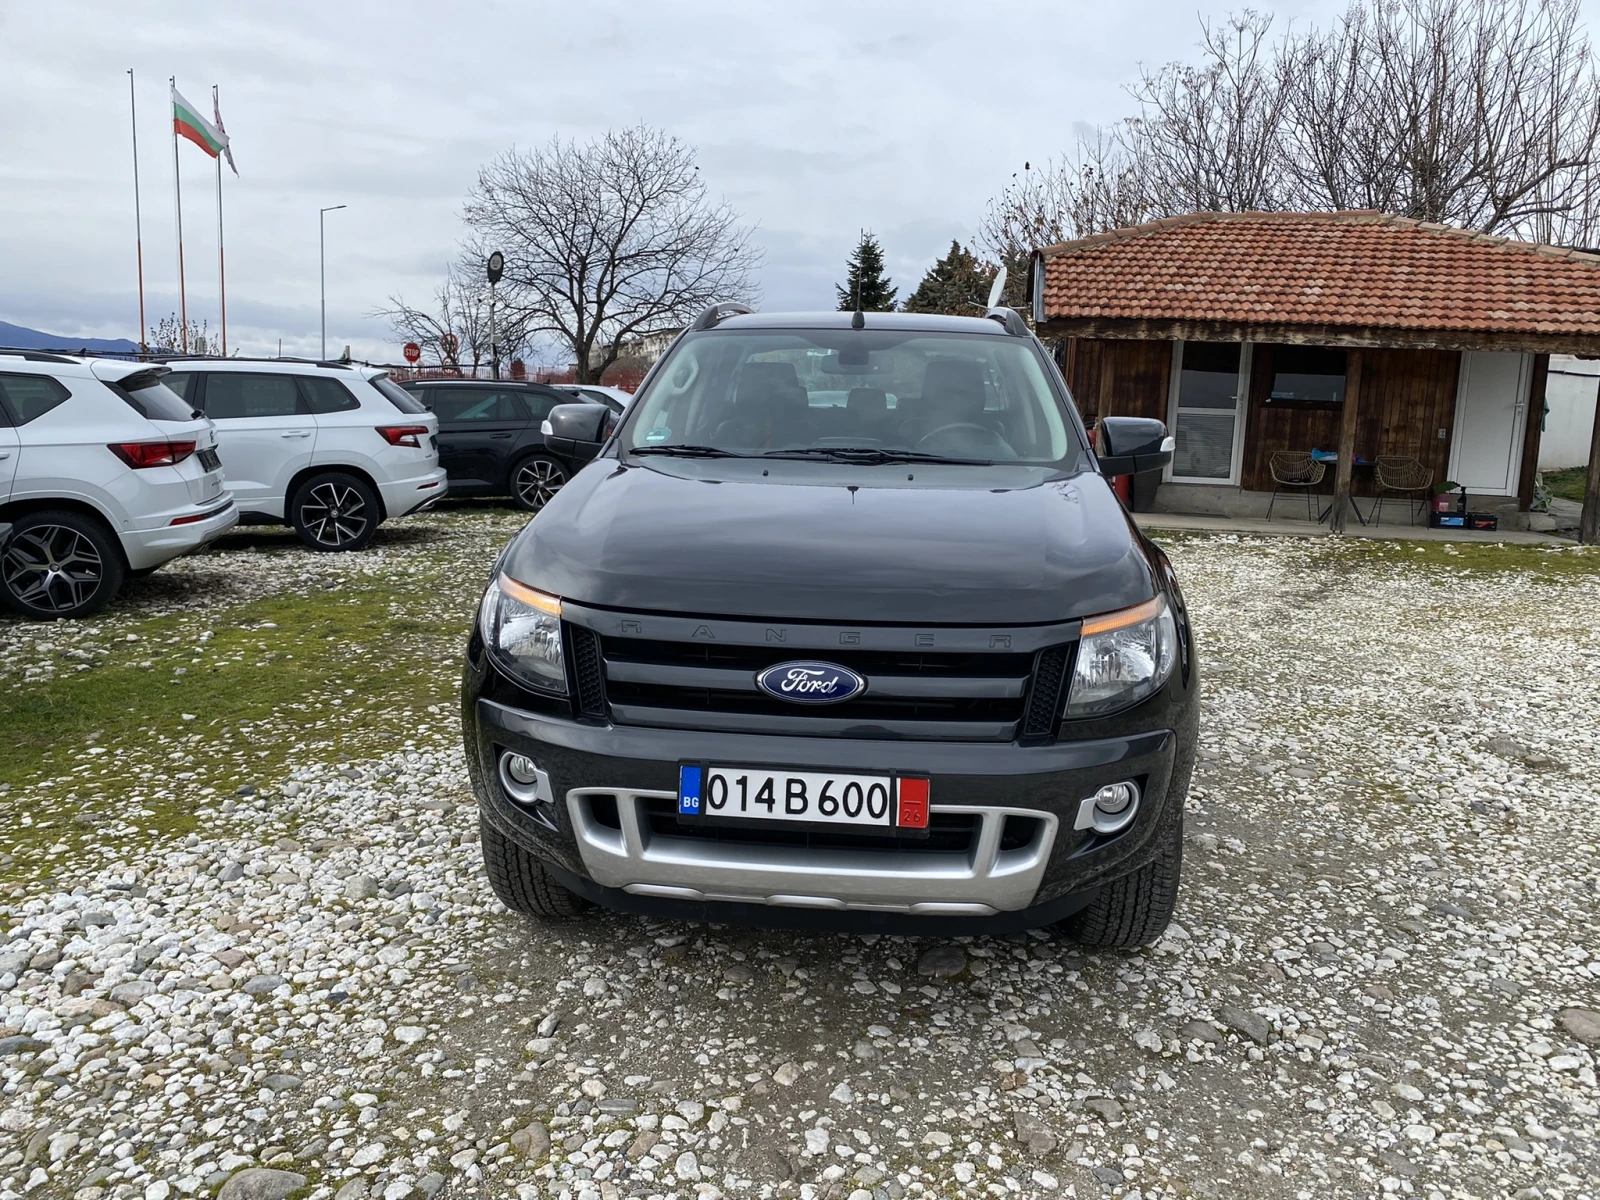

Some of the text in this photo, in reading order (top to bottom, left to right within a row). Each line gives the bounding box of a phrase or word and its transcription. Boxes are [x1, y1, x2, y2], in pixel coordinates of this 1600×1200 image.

[405, 348, 419, 357] STOP
[620, 619, 1012, 648] RANGER
[780, 668, 839, 694] Ford
[683, 796, 699, 808] BG
[903, 809, 921, 823] 26
